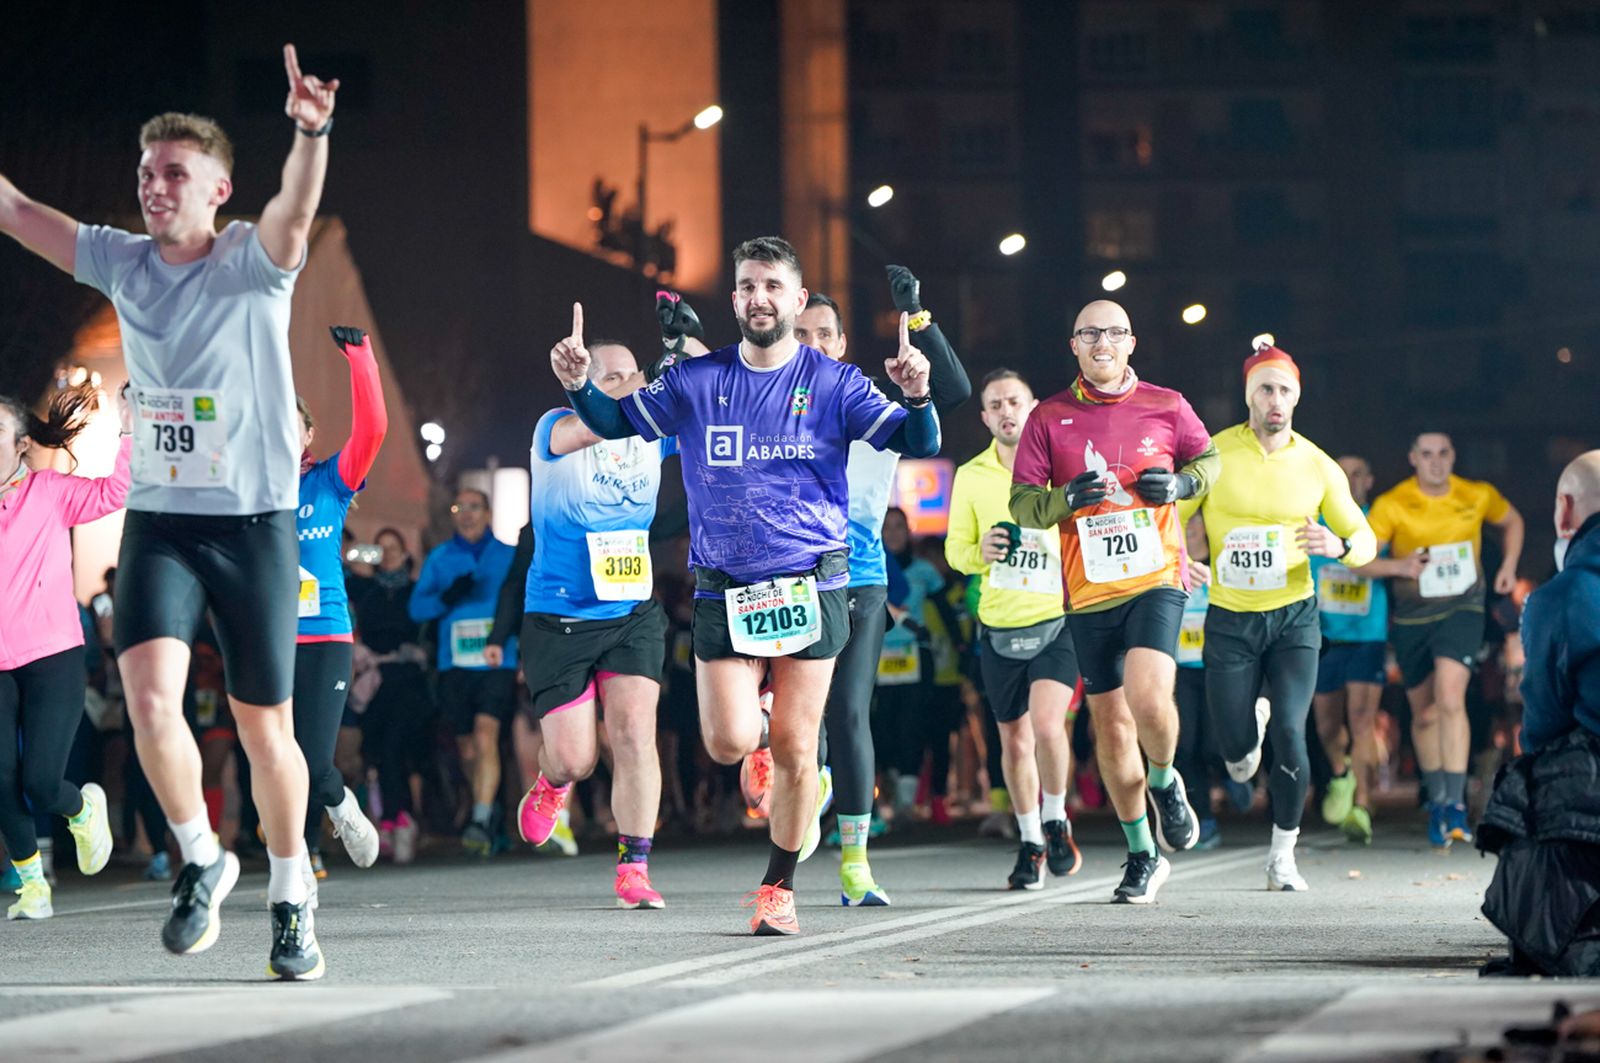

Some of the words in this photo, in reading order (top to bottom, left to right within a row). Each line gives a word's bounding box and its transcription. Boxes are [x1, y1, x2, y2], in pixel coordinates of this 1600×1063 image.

[152, 424, 195, 453] 739
[750, 432, 812, 443] Fundación
[746, 444, 816, 460] ABADES
[1102, 533, 1139, 557] 720
[605, 556, 642, 576] 3193
[1230, 549, 1273, 568] 4319
[747, 591, 771, 603] NOCHE
[772, 588, 783, 598] DE
[738, 603, 754, 614] SAN
[742, 604, 808, 635] 12103
